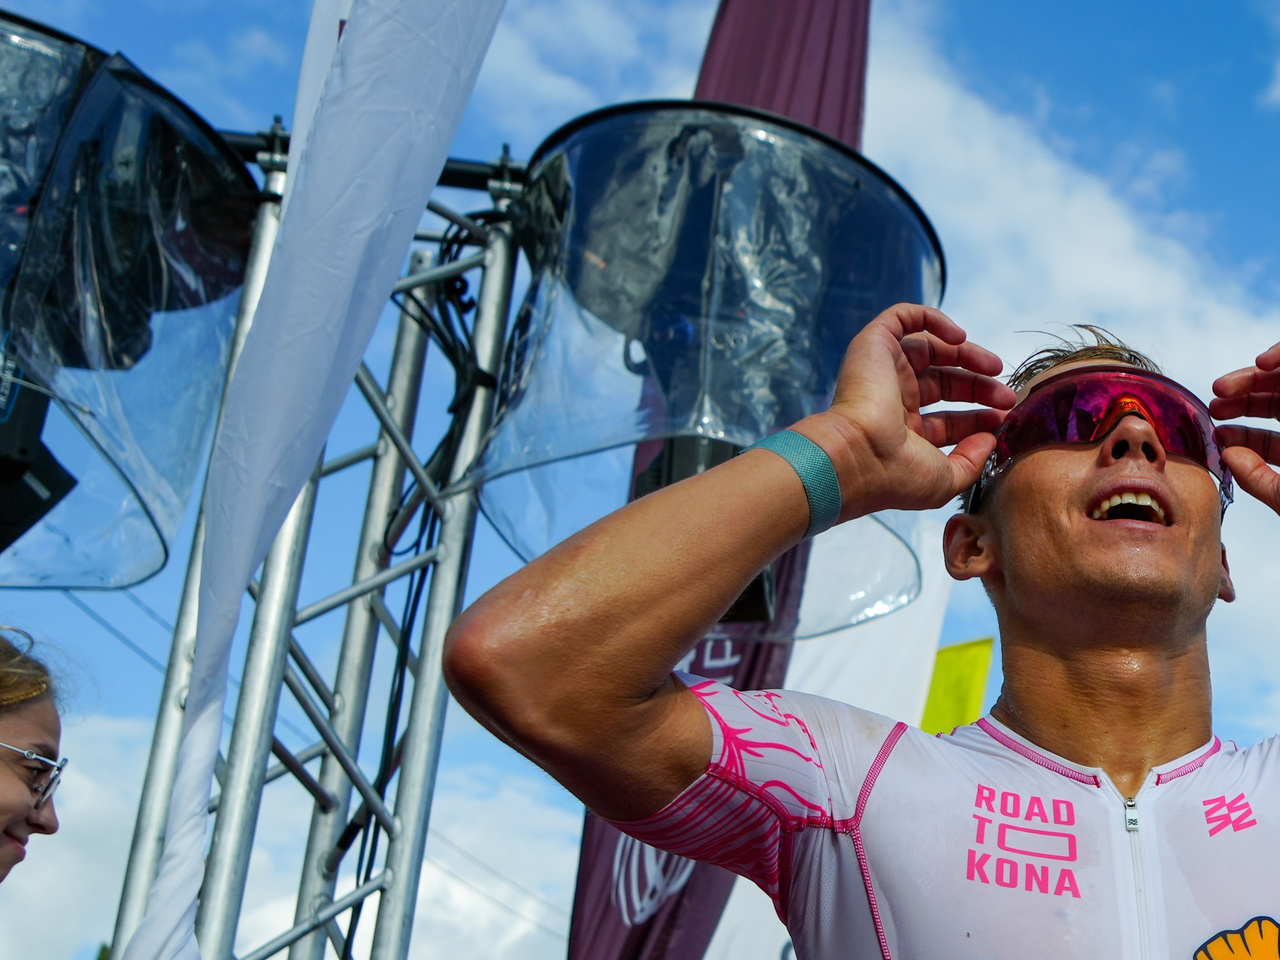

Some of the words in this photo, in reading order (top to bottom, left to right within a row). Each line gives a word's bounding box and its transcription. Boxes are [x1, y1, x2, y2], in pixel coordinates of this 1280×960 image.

[974, 783, 1076, 826] ROAD
[972, 813, 1078, 862] TO
[966, 848, 1082, 899] KONA
